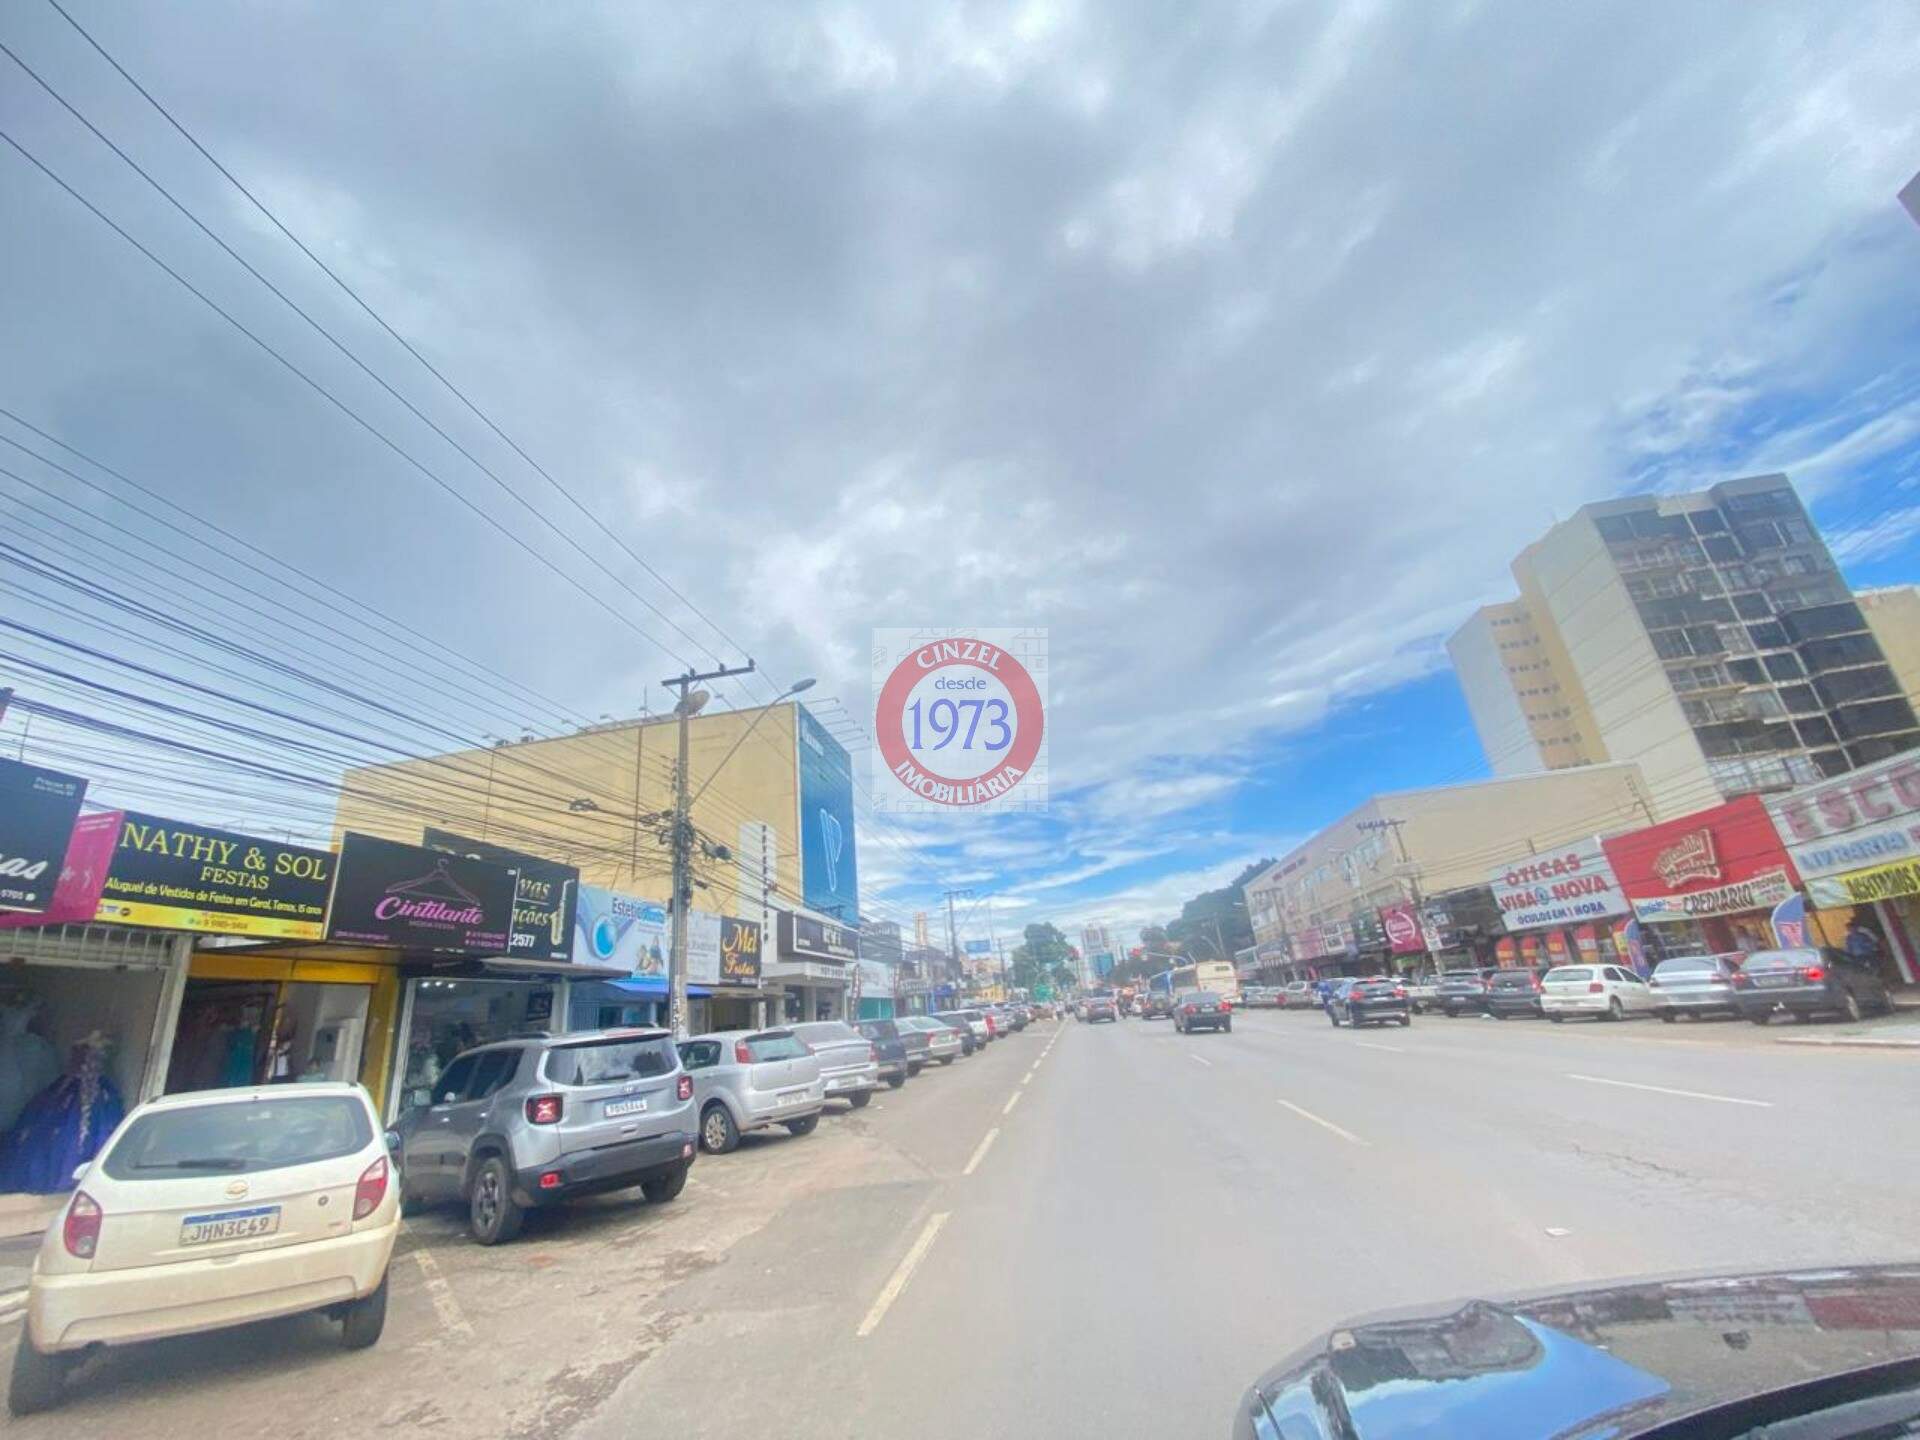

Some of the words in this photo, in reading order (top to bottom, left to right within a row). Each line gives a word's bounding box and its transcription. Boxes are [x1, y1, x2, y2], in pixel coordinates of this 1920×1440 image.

[120, 822, 239, 864] NATHY
[243, 847, 267, 871] &
[275, 852, 327, 880] SOL
[105, 877, 144, 892] Aluguel
[145, 882, 158, 894] de
[160, 885, 195, 899] Vestidos
[196, 889, 208, 901] de
[200, 866, 270, 890] FESTAS
[1552, 874, 1609, 901] NOVA
[375, 897, 483, 925] Cintilante
[1574, 901, 1606, 915] HORA
[191, 1216, 270, 1241] JHN3C49
